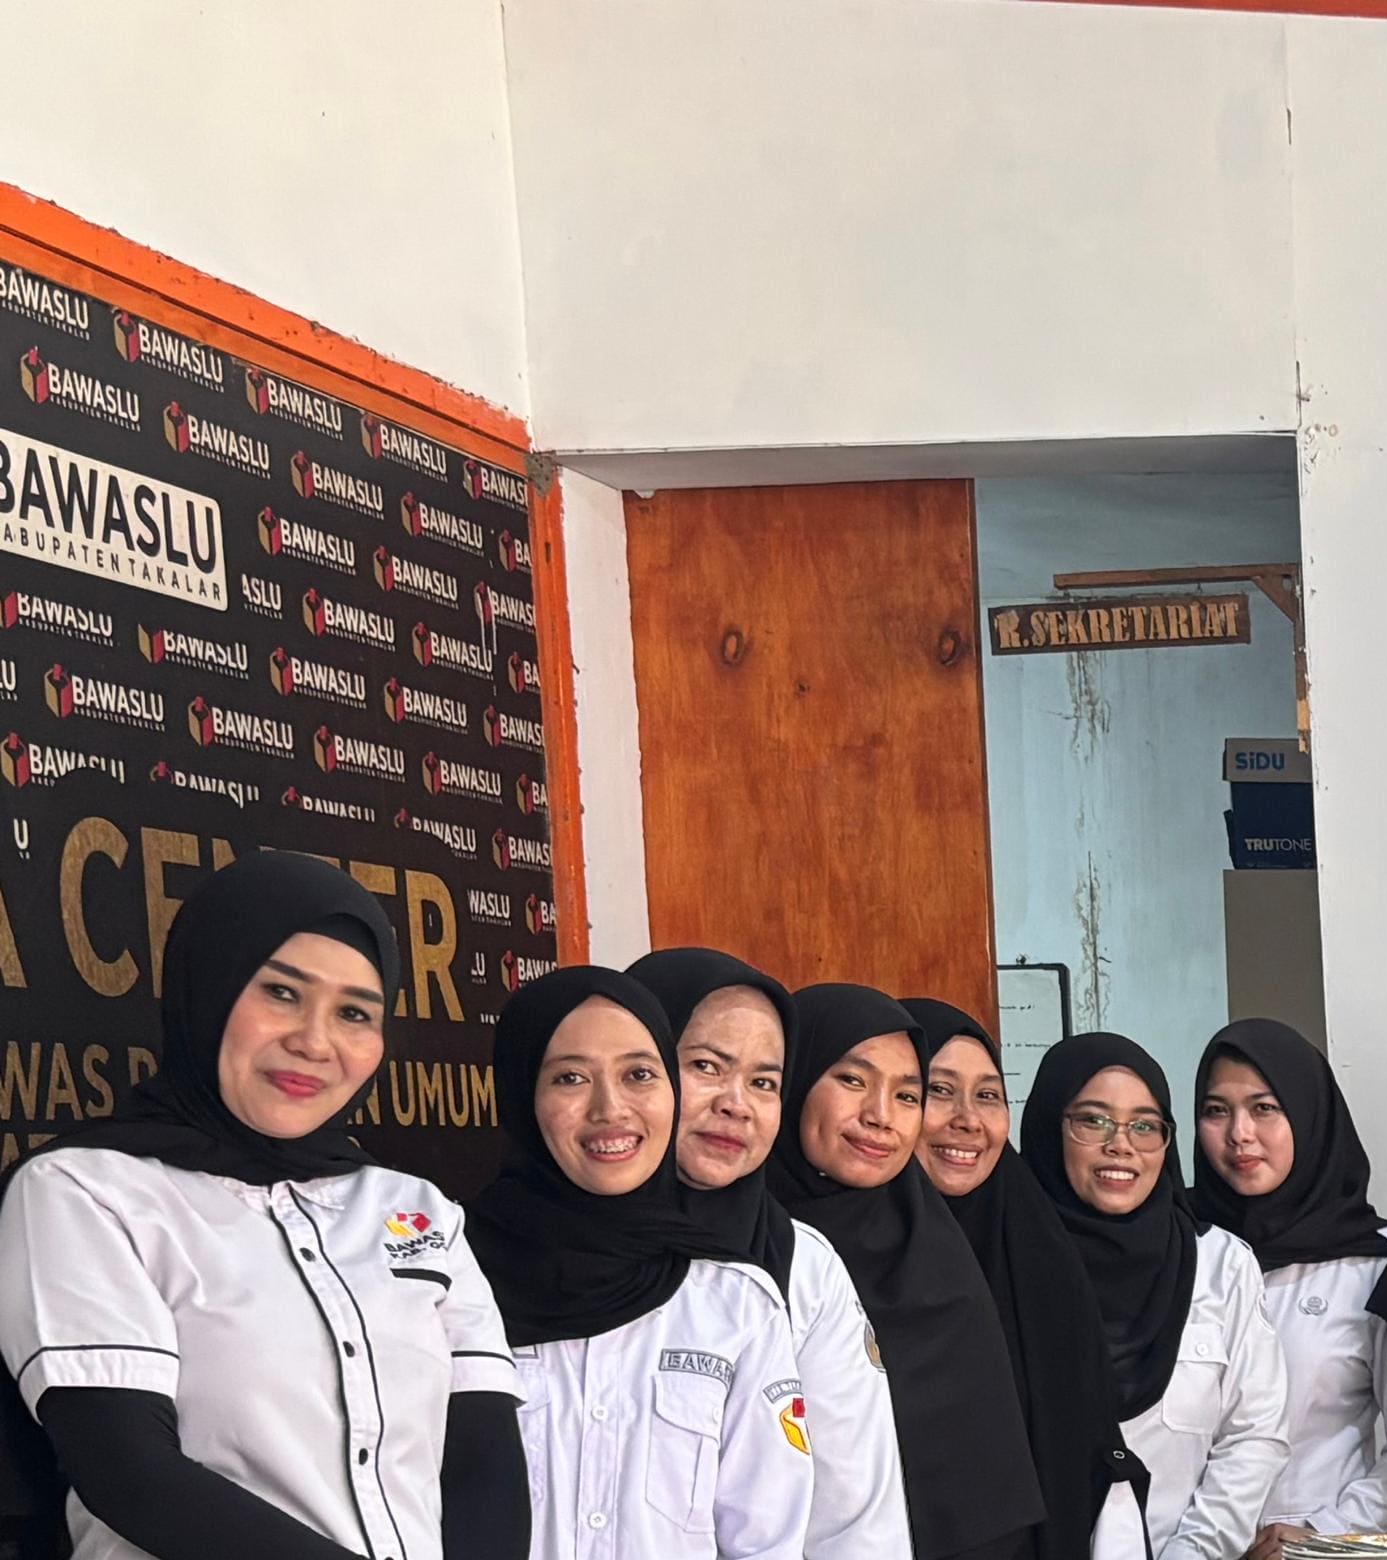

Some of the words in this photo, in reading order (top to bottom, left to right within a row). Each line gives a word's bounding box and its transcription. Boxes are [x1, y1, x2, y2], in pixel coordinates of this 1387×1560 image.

[139, 324, 223, 383] BAWASLU
[48, 363, 140, 422] BAWASLU
[267, 378, 342, 432] BAWASLU
[188, 414, 269, 471] BAWASLU
[380, 424, 447, 474] BAWASLU
[311, 462, 383, 512] BAWASLU
[481, 467, 528, 506] BAWAS
[280, 517, 355, 567] BAWASLU
[419, 502, 483, 549] BAWASLU
[128, 558, 221, 601] TAKALAR
[391, 555, 458, 602] BAWASLU
[323, 598, 395, 643] BAWASLU
[491, 590, 535, 627] BAWAS
[431, 632, 493, 673] BAWASLU
[71, 675, 164, 722] BAWASLU
[291, 657, 366, 701] BAWASLU
[212, 707, 294, 751] BAWASLU
[402, 687, 467, 727] BAWASLU
[500, 713, 545, 747] BAWAS
[334, 735, 404, 775] BAWASLU
[440, 759, 501, 796] BAWASLU
[1245, 838, 1312, 851] TRUTONE
[389, 1060, 498, 1127] UMUM
